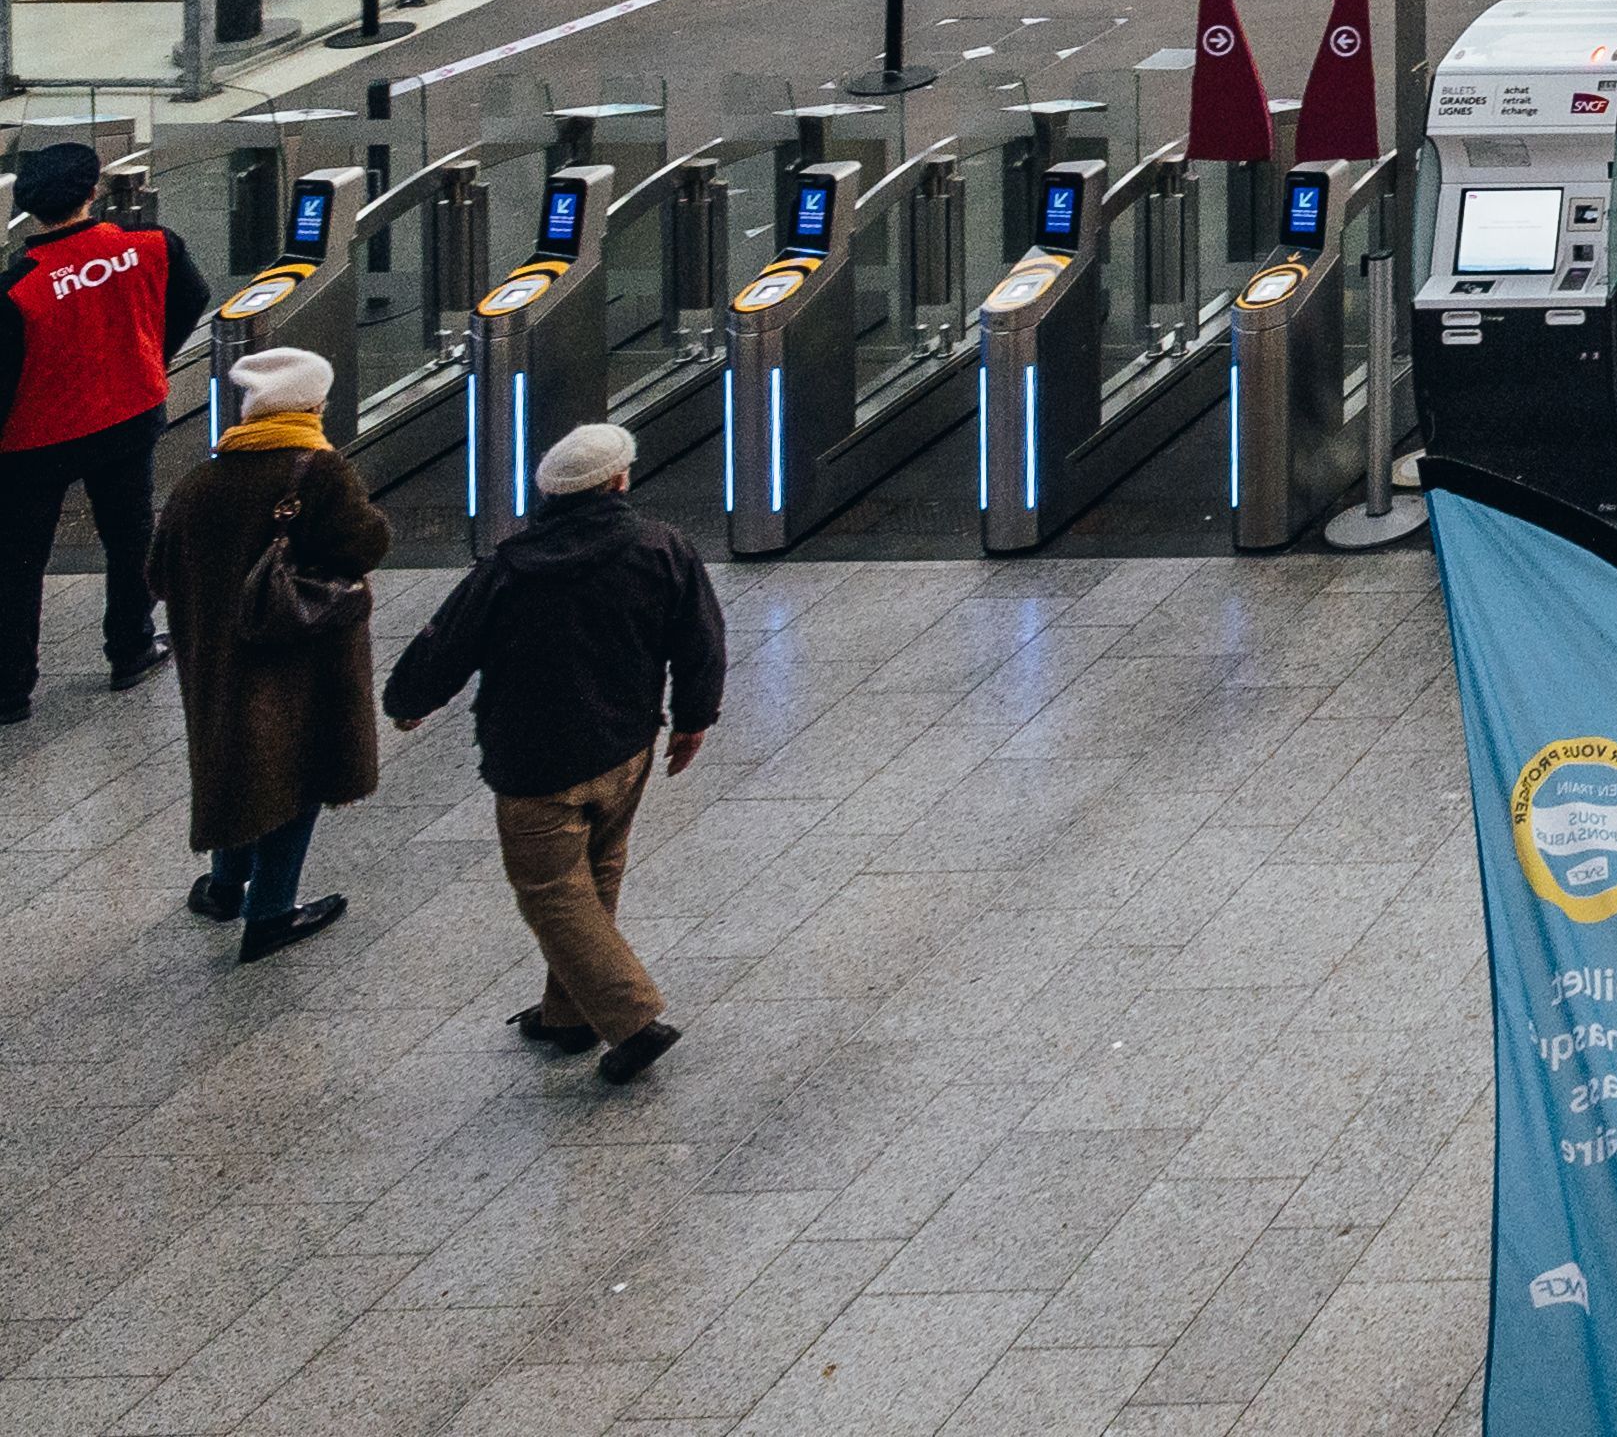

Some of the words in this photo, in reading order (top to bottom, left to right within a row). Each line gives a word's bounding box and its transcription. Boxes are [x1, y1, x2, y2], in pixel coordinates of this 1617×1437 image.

[1441, 85, 1477, 95] BILLETS
[1503, 85, 1530, 95] achat
[1440, 96, 1488, 106] GRANDES
[1502, 96, 1532, 105] retrait
[1438, 106, 1474, 116] LIGNES
[1501, 105, 1539, 117] échange
[1574, 100, 1607, 112] SNCF
[49, 264, 75, 280] TGV
[53, 247, 139, 300] inOui
